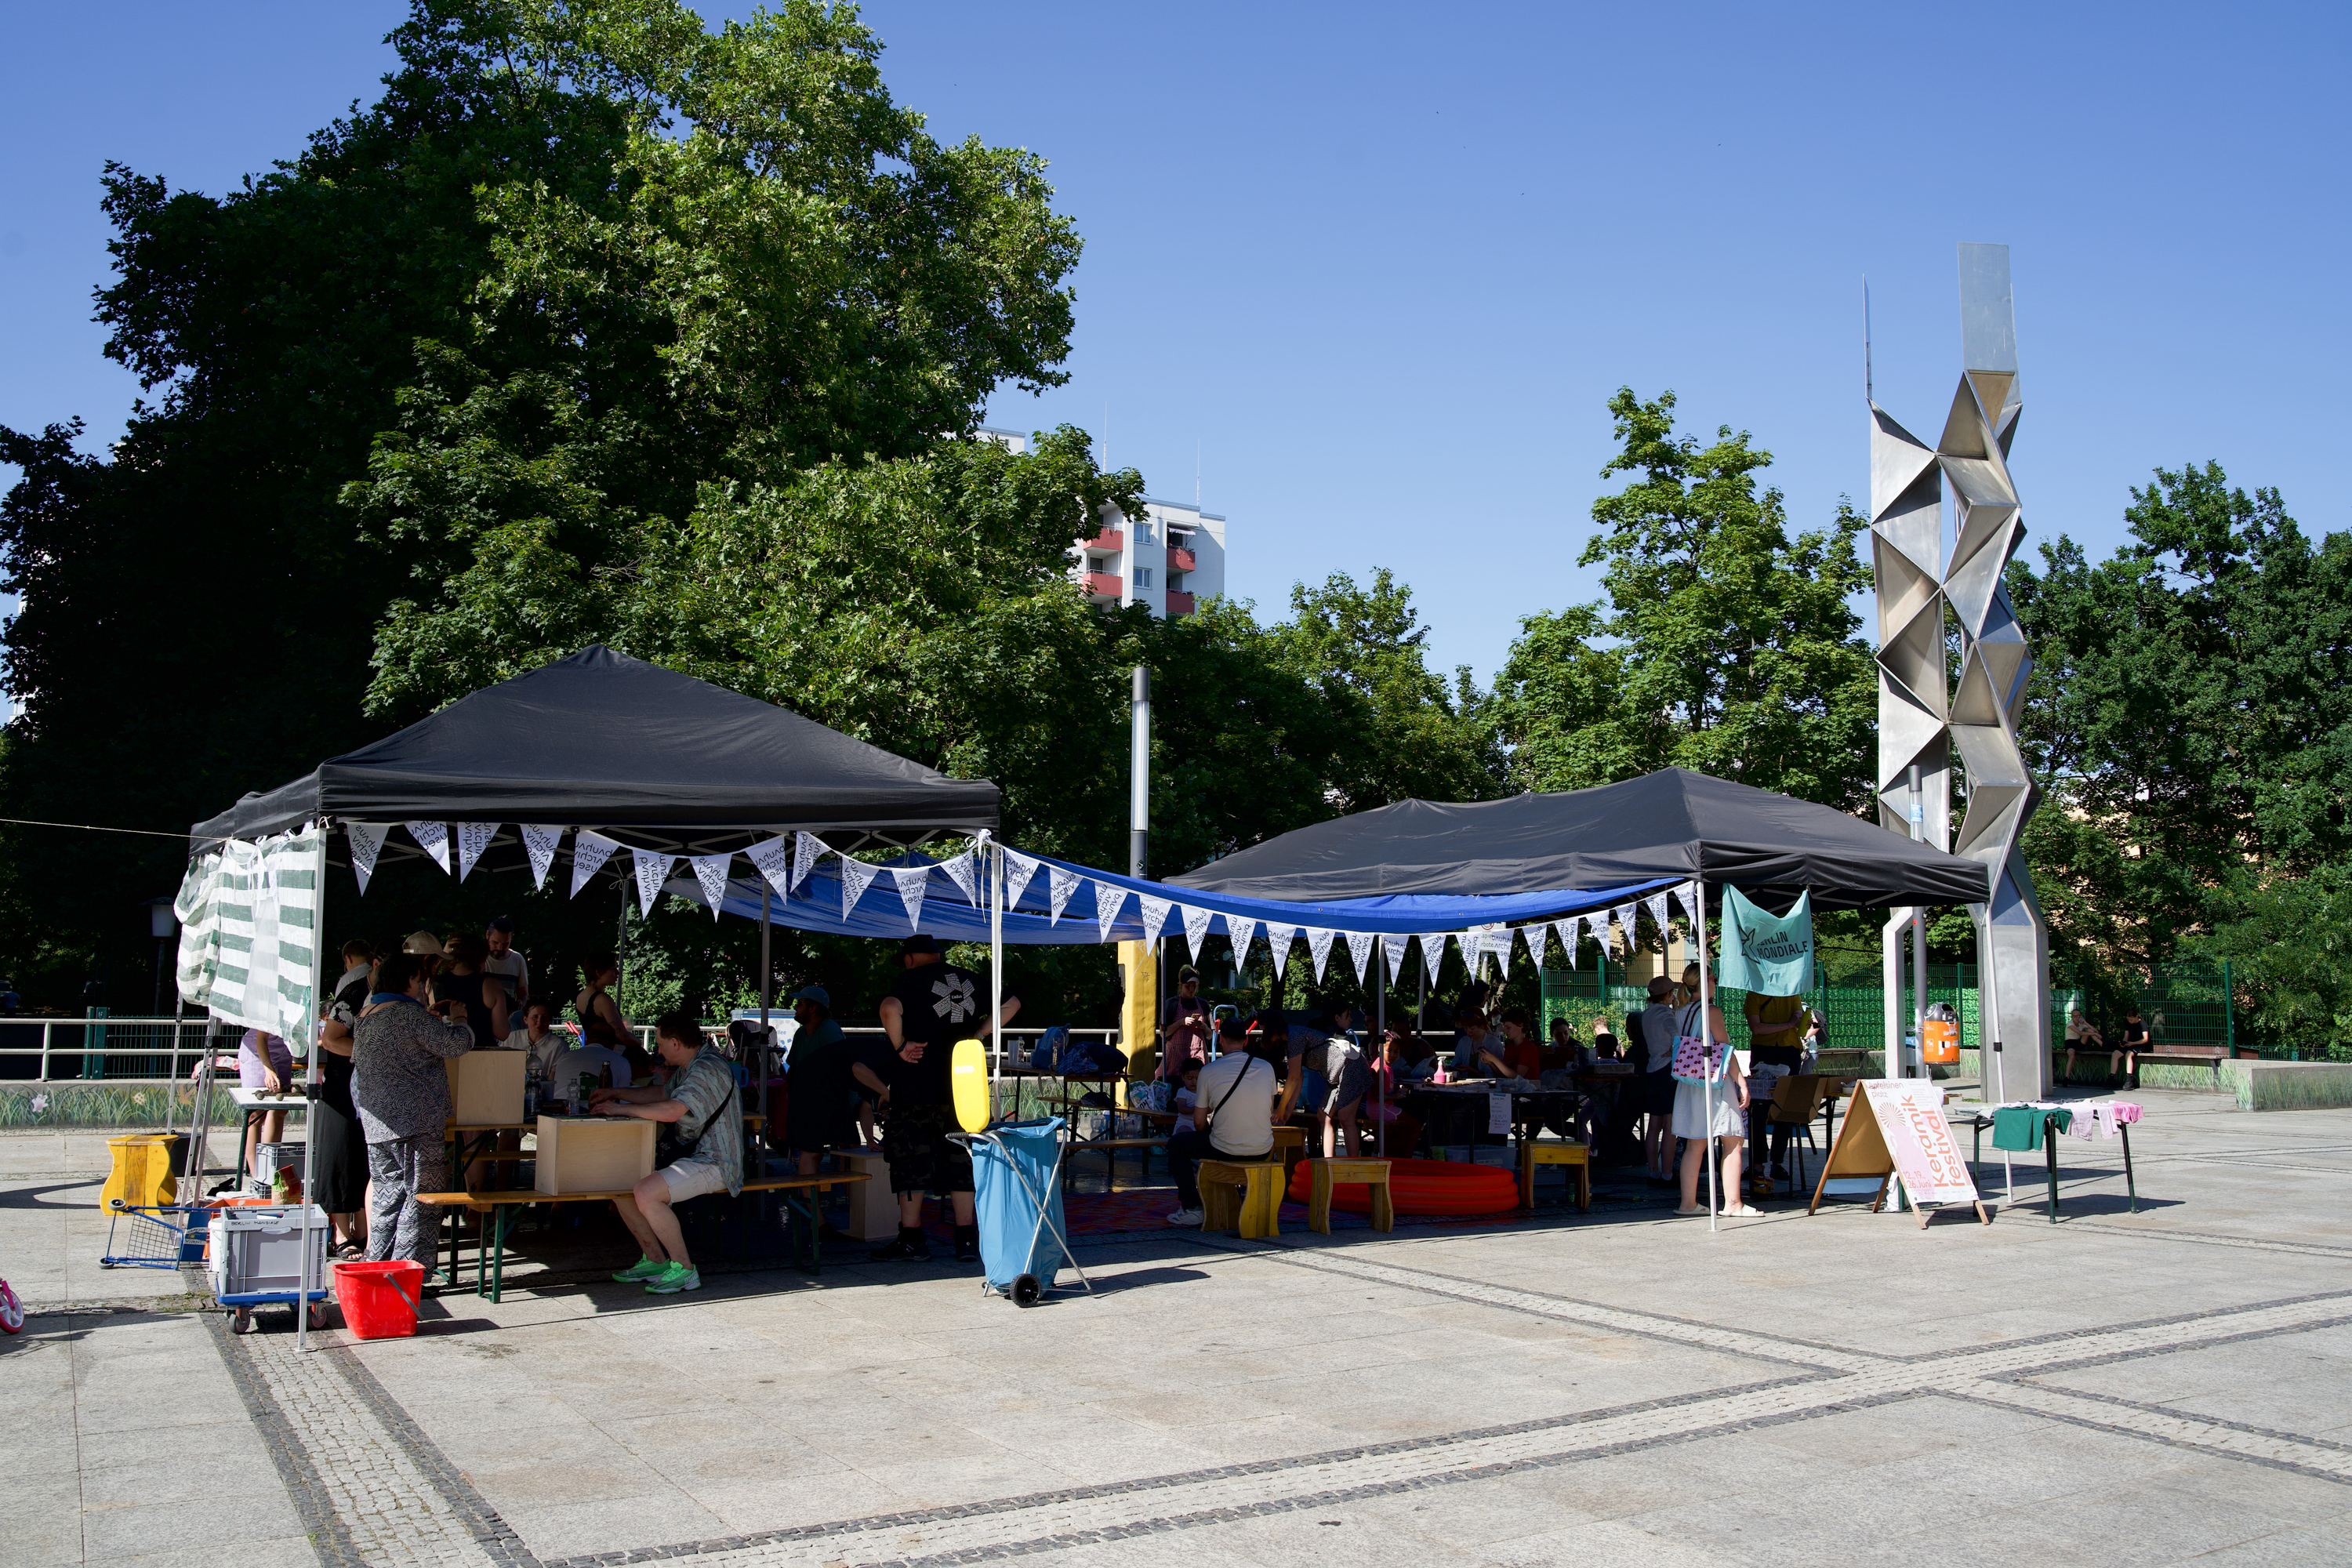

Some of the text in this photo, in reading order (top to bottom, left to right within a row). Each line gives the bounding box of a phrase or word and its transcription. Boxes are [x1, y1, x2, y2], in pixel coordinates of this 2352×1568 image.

[1052, 894, 1073, 911] muse
[1189, 931, 1207, 950] muse
[1316, 950, 1330, 970] muse
[1534, 943, 1545, 962] muse
[1756, 941, 1809, 960] MONDIALE
[1429, 953, 1443, 974] muse
[1867, 1081, 1904, 1090] Apfelsinen
[1871, 1091, 1888, 1099] platz
[1900, 1094, 1949, 1188] keramik
[1920, 1110, 1965, 1187] festival
